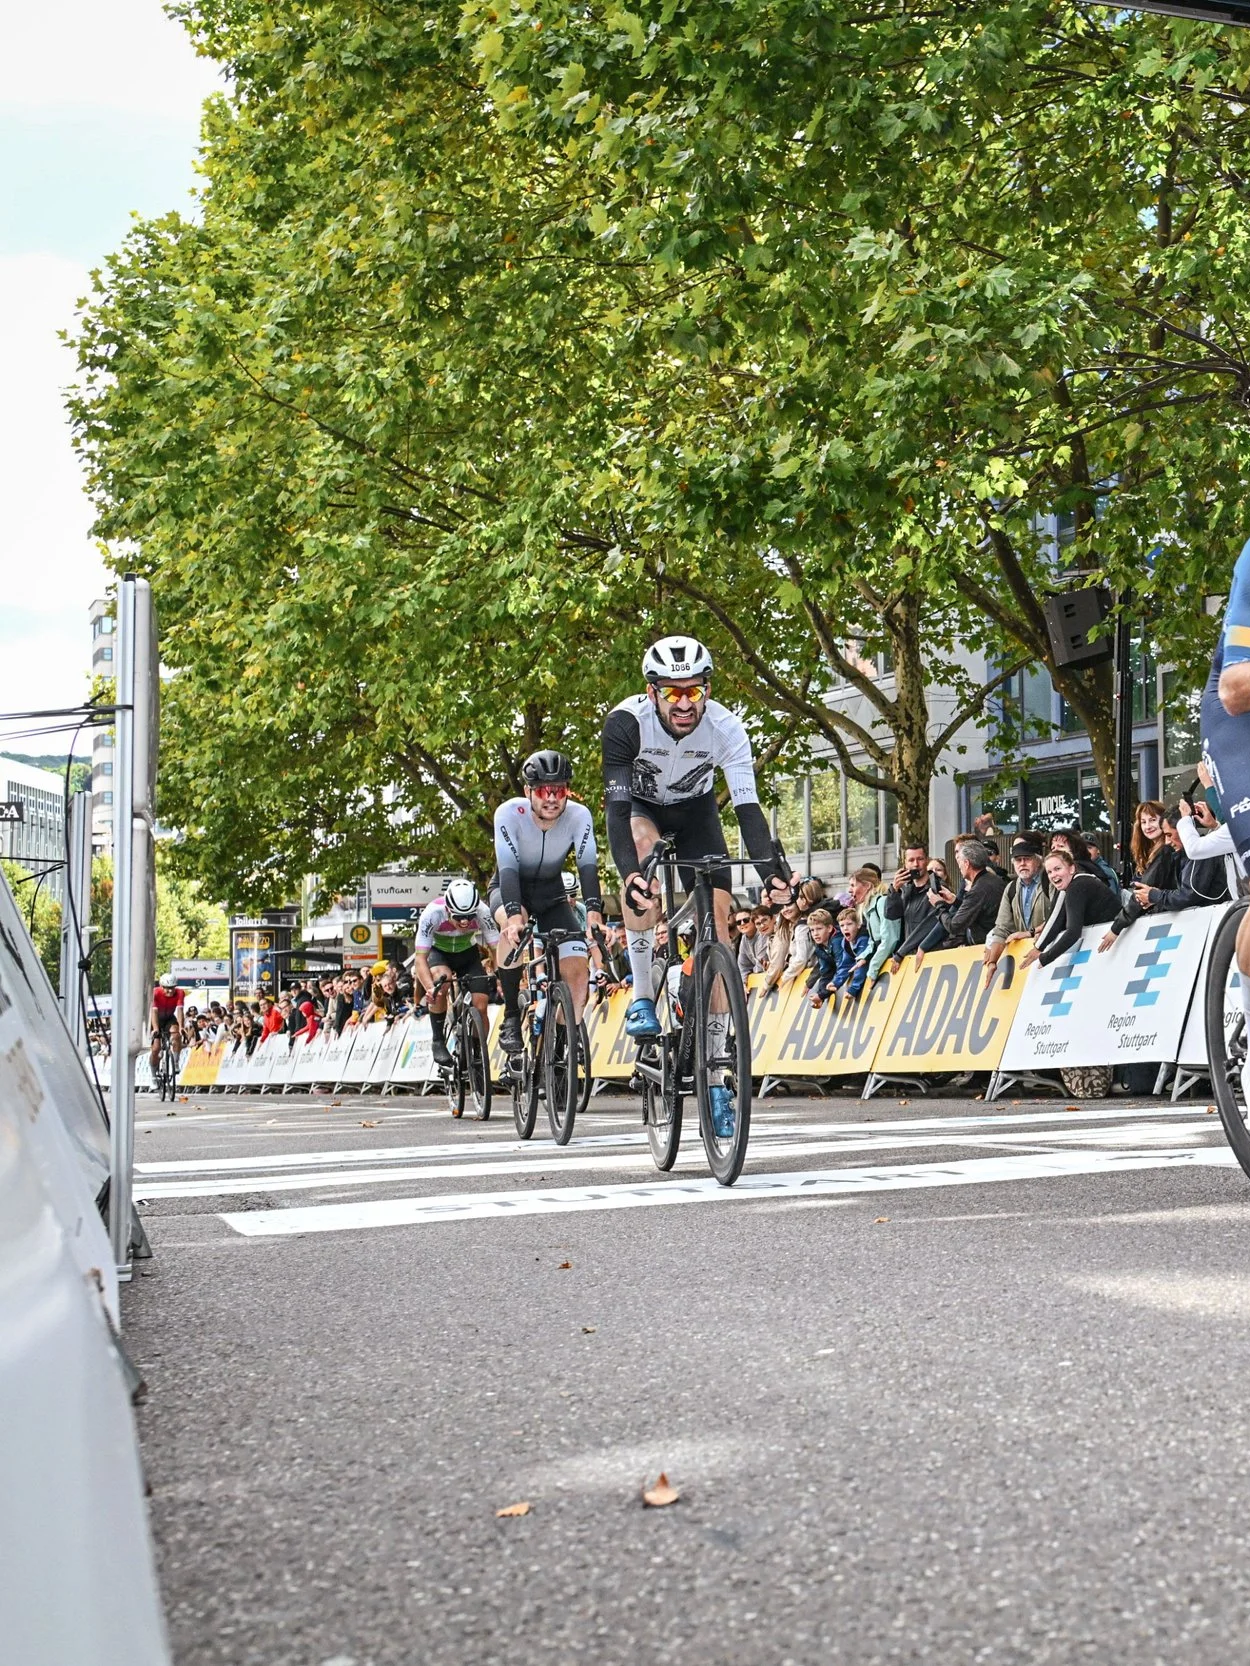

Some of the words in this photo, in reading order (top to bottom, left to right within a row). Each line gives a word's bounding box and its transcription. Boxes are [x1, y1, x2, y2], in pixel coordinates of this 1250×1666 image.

[195, 979, 206, 987] 50
[887, 954, 1016, 1057] ADAC
[778, 971, 891, 1061] ADAC
[1107, 1011, 1137, 1032] Region
[1025, 1020, 1052, 1040] Region
[1034, 1040, 1070, 1058] Stuttgart
[1117, 1031, 1158, 1051] Stuttgart
